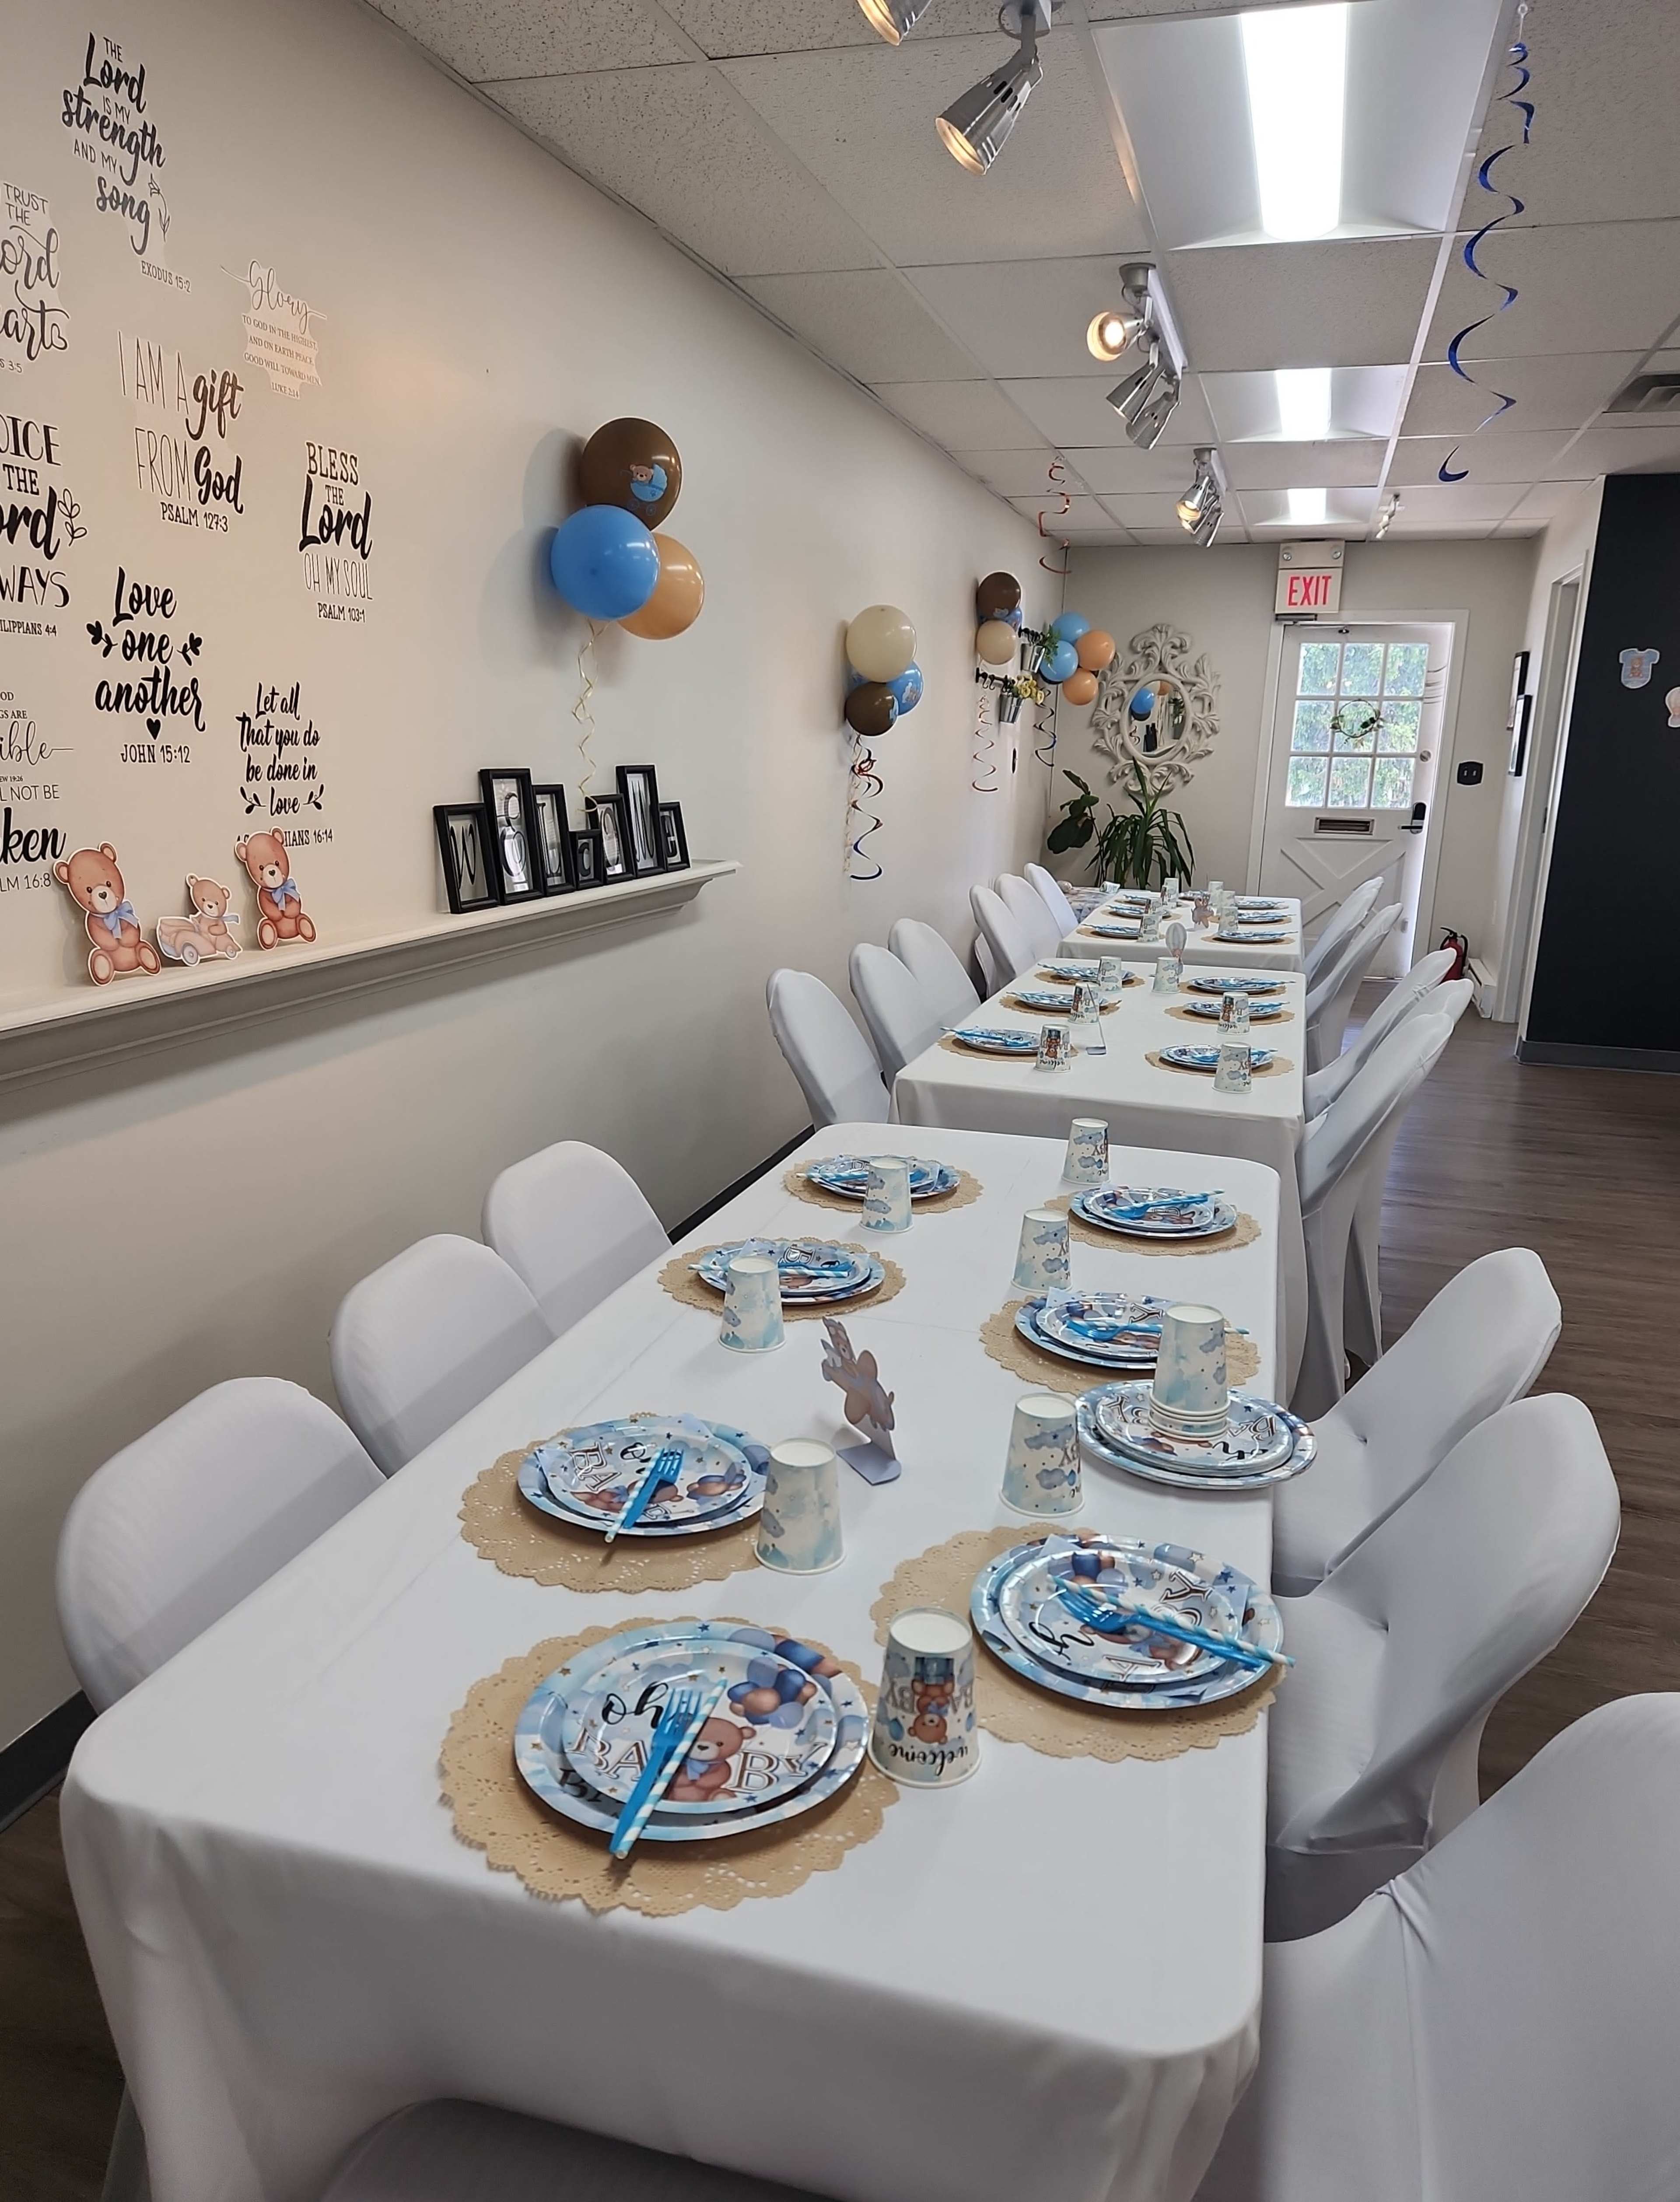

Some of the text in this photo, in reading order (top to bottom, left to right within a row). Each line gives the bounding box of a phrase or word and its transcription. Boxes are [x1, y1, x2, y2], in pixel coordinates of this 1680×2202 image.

[103, 36, 122, 63] THE
[83, 32, 146, 113] Lord
[103, 95, 130, 124] IS MY
[62, 85, 166, 186] strength
[74, 139, 117, 173] AND MY
[4, 183, 48, 214] TRUST
[5, 203, 31, 226] THE
[96, 176, 150, 256] song
[141, 260, 191, 293] EXODUS 15:2
[220, 260, 326, 335] Glory
[242, 315, 252, 325] TO
[253, 319, 267, 331] GOD
[269, 324, 276, 334] IN
[278, 328, 290, 340] THE
[249, 336, 263, 347] AND
[264, 340, 273, 351] ON
[275, 344, 294, 358] EARTH
[9, 361, 22, 373] 3:5
[244, 353, 263, 365] GOOD
[265, 359, 279, 371] WILL
[280, 364, 305, 380] TOWARD
[119, 331, 244, 440] I AM A gift
[272, 382, 299, 398] LUKE 2:14
[135, 427, 244, 514] FROM God
[306, 442, 358, 485] BLESS
[3, 463, 39, 496] THE
[325, 484, 344, 506] THE
[160, 502, 228, 532] PSALM 127:3
[299, 473, 372, 560] Lord
[304, 553, 373, 600] OH MY SOUL
[1288, 576, 1332, 606] EXIT
[112, 566, 177, 627] Love
[318, 602, 365, 623] PSALM 103:1
[45, 624, 57, 637] 4:4
[122, 630, 174, 664] one
[95, 665, 206, 732] another
[256, 681, 300, 721] Let all
[10, 710, 28, 719] ARE
[235, 711, 320, 760] That you do
[120, 744, 190, 763] JOHN 15:12
[246, 753, 318, 783] be done in
[10, 785, 39, 801] NOT
[43, 784, 60, 799] BE
[270, 786, 300, 816] love
[314, 828, 333, 844] 16:14
[24, 872, 51, 889] 16:8
[601, 1681, 669, 1729] oh
[889, 1743, 968, 1777] welcome
